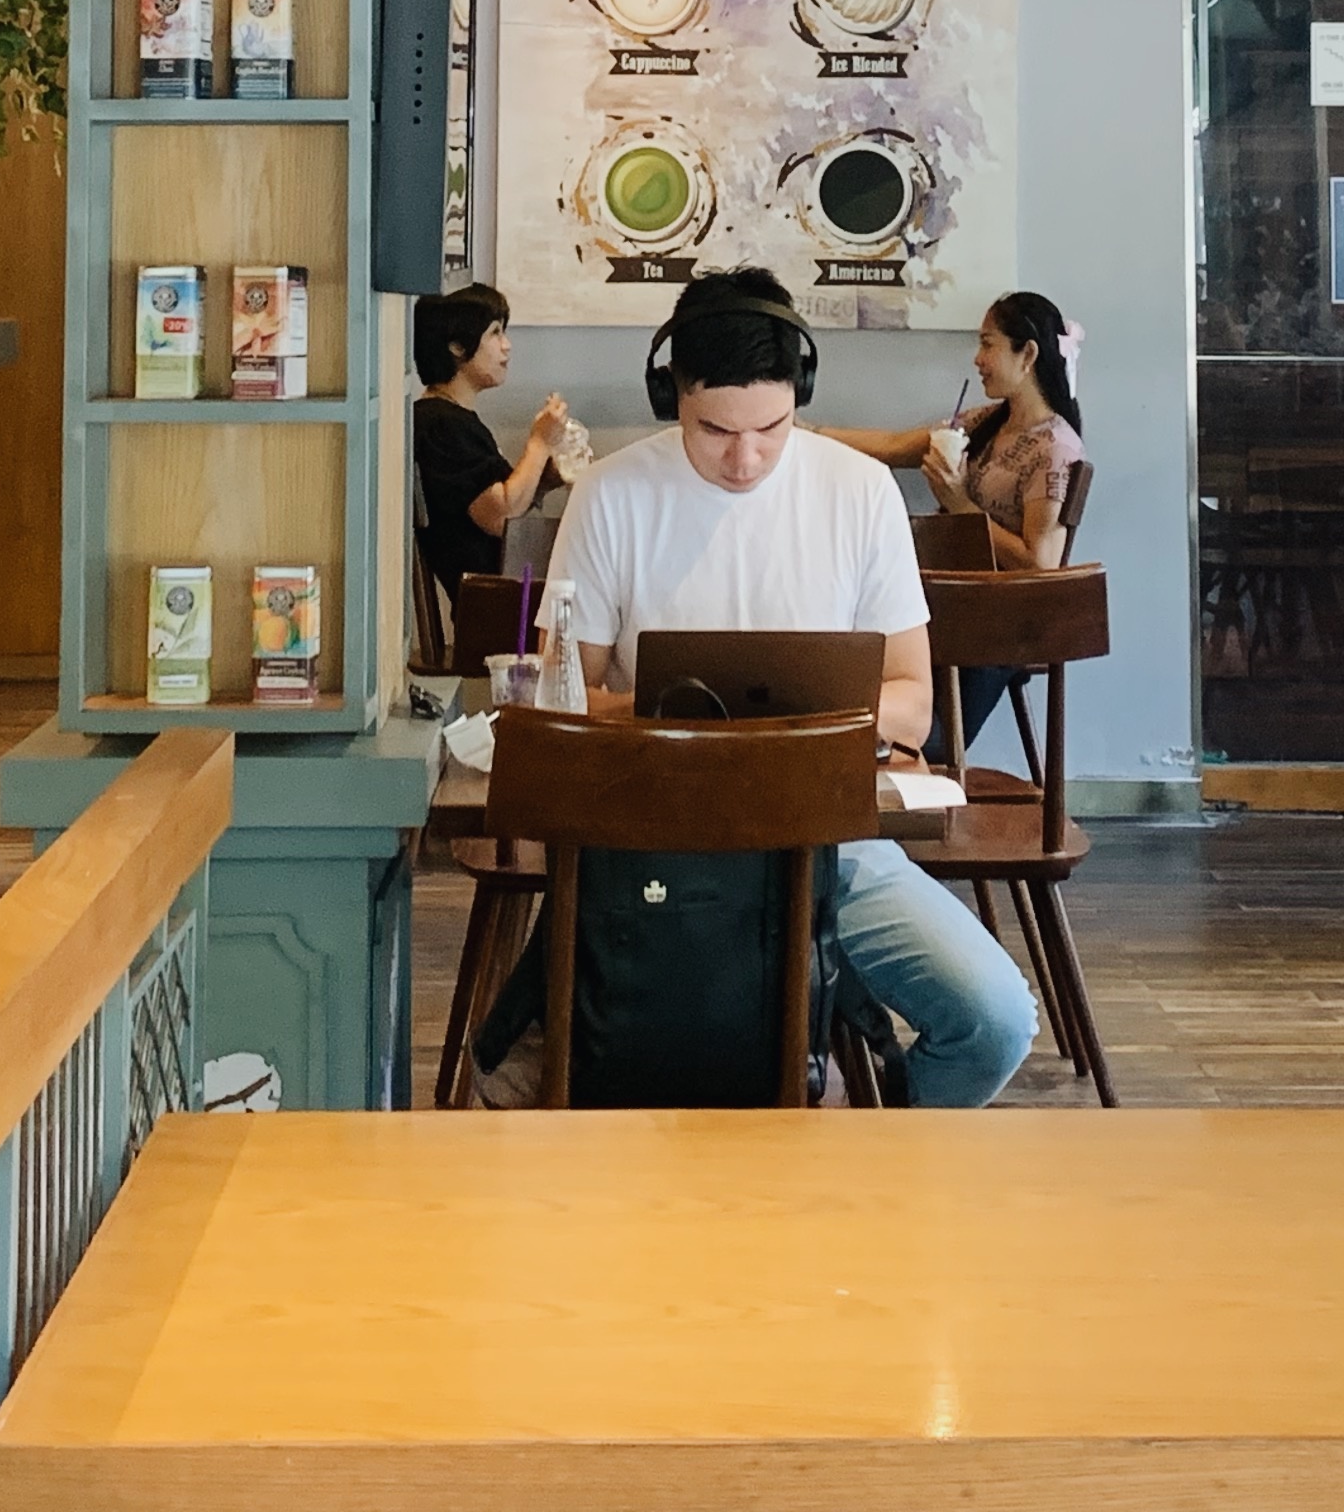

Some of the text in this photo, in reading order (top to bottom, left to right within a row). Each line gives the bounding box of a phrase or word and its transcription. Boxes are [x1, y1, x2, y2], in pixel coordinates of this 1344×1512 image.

[620, 52, 691, 74] Cappuccino
[831, 55, 898, 73] Ice Blended
[643, 261, 664, 279] Tea
[828, 263, 896, 281] Americano
